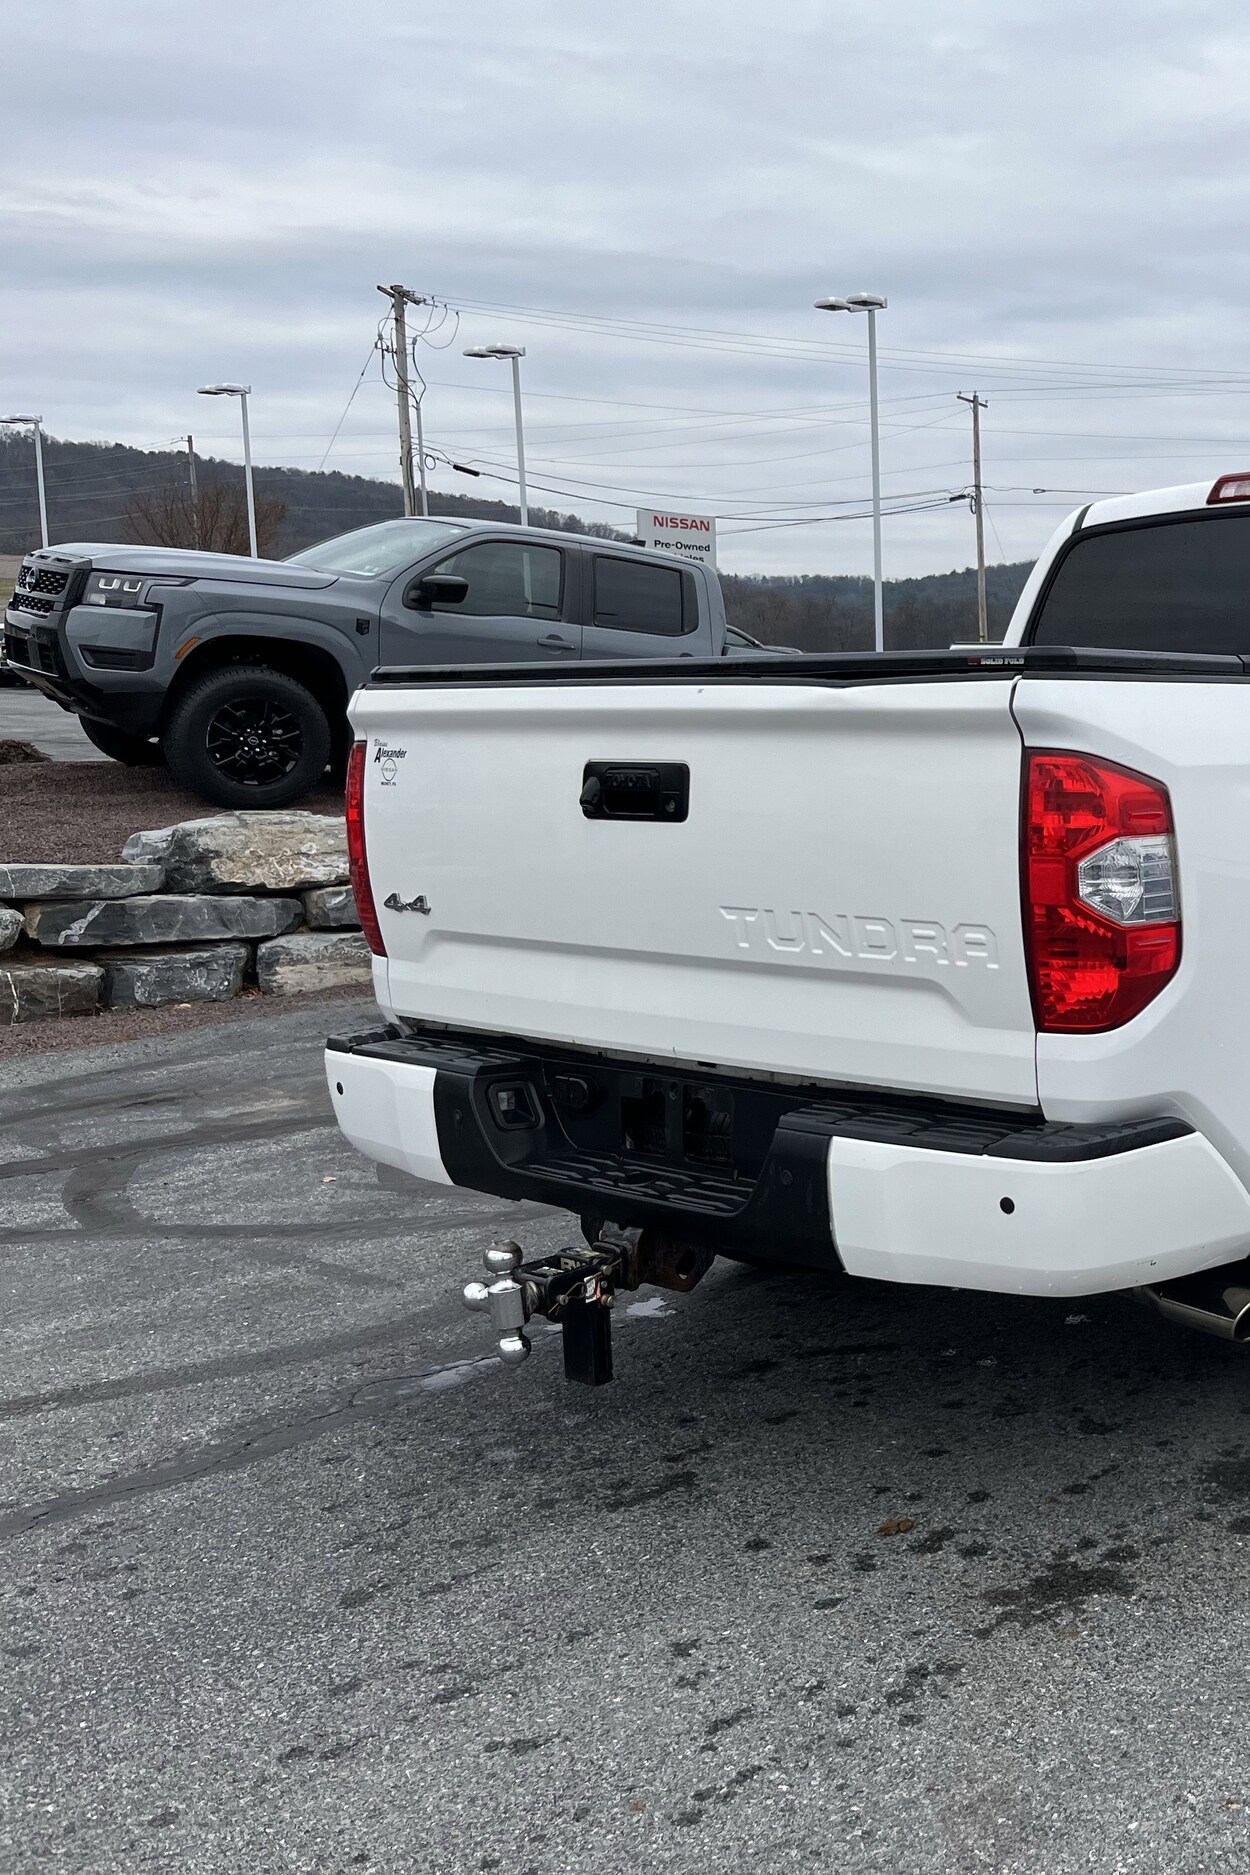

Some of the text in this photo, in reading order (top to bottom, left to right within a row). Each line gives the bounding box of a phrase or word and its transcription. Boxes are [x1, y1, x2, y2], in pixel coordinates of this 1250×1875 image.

[653, 515, 710, 531] NISSAN
[654, 539, 711, 552] Pre-Owned
[980, 657, 1003, 665] SOLID
[1004, 657, 1025, 665] FOLD
[373, 747, 407, 763] Alexander
[719, 905, 999, 969] TUNDRA
